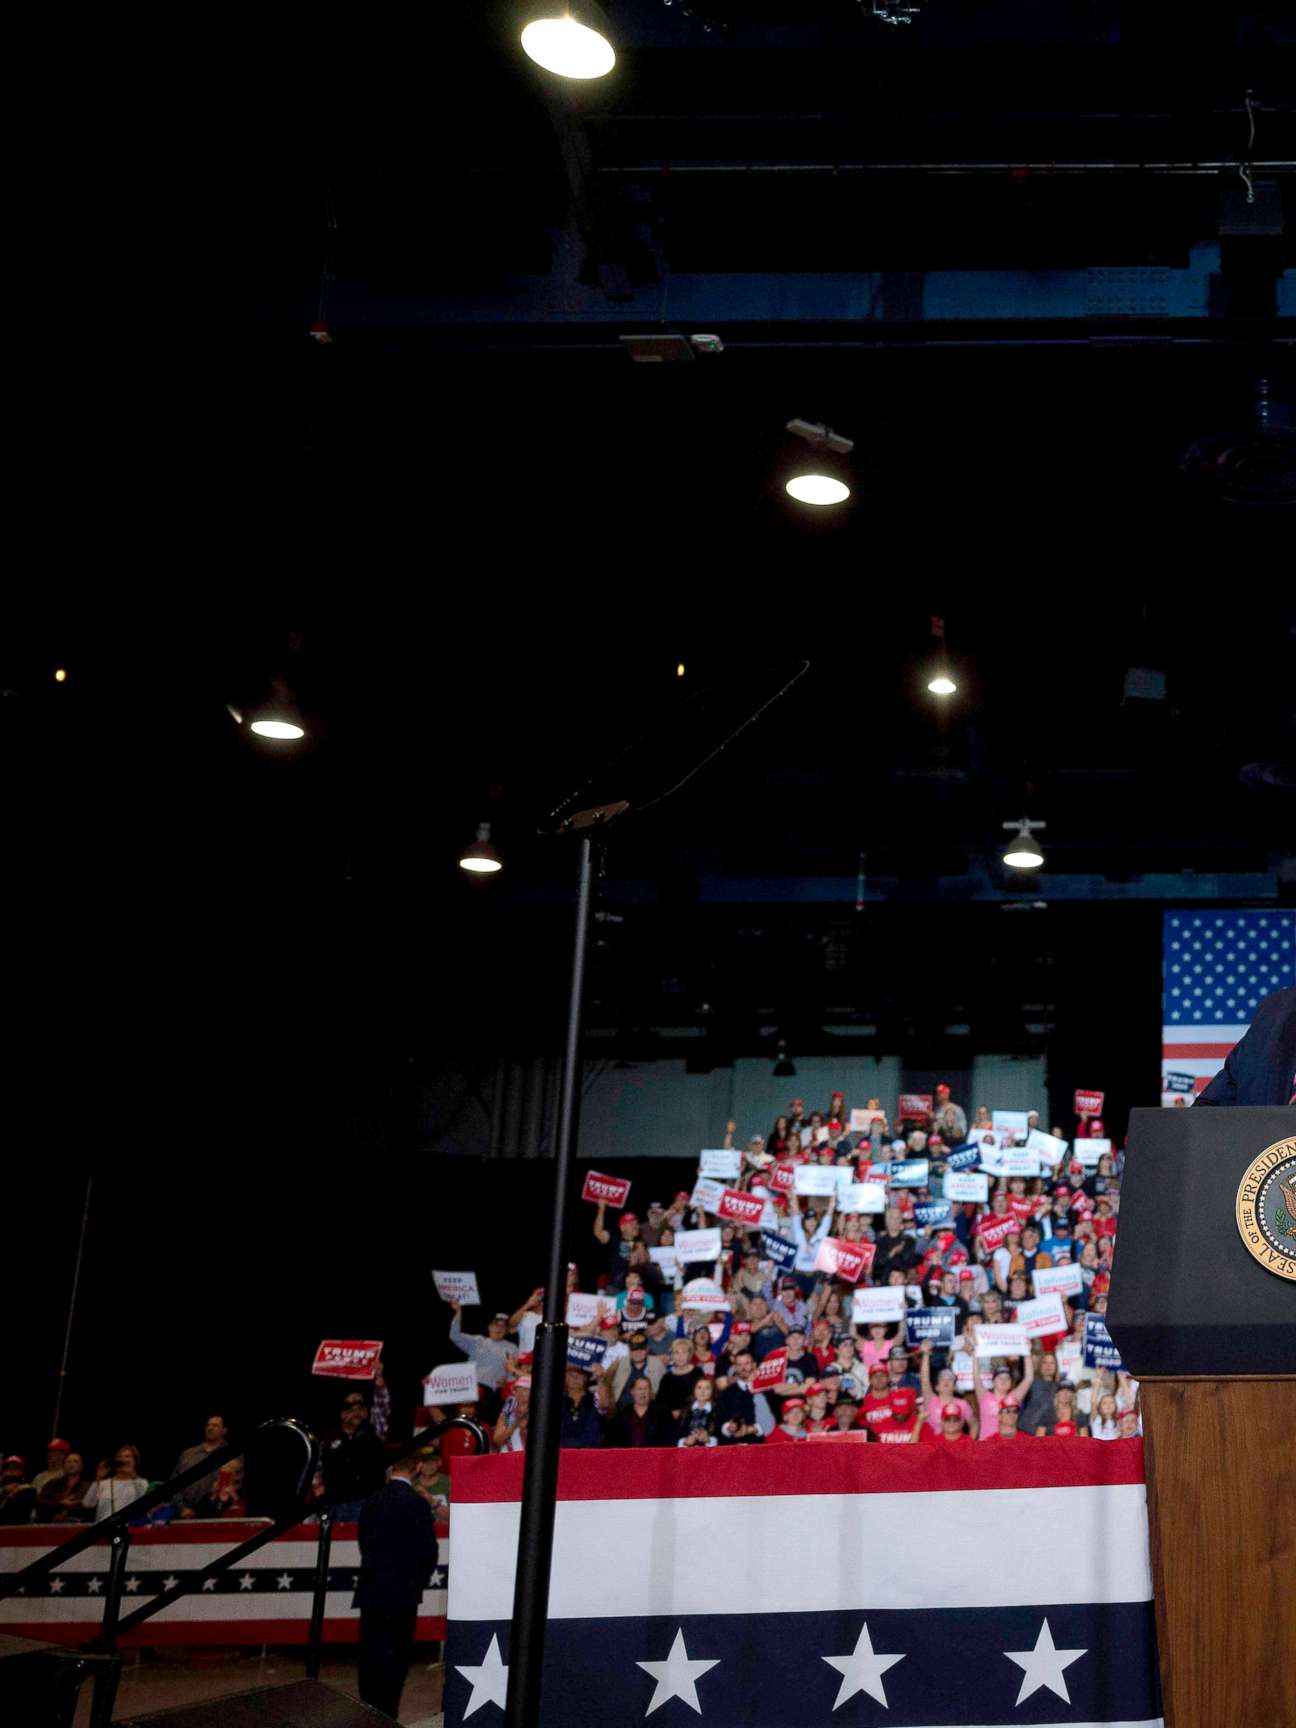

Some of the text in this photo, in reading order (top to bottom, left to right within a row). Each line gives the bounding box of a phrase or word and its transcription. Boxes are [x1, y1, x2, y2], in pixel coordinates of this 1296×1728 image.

[724, 1196, 763, 1212] TRUMP
[1243, 1208, 1254, 1229] THE
[762, 1234, 797, 1256] TRUMP
[1247, 1231, 1260, 1244] OF
[1258, 1243, 1296, 1274] SEAL
[907, 1316, 951, 1326] TRUMP
[323, 1347, 376, 1359] TRUMP
[430, 1374, 473, 1389] Women
